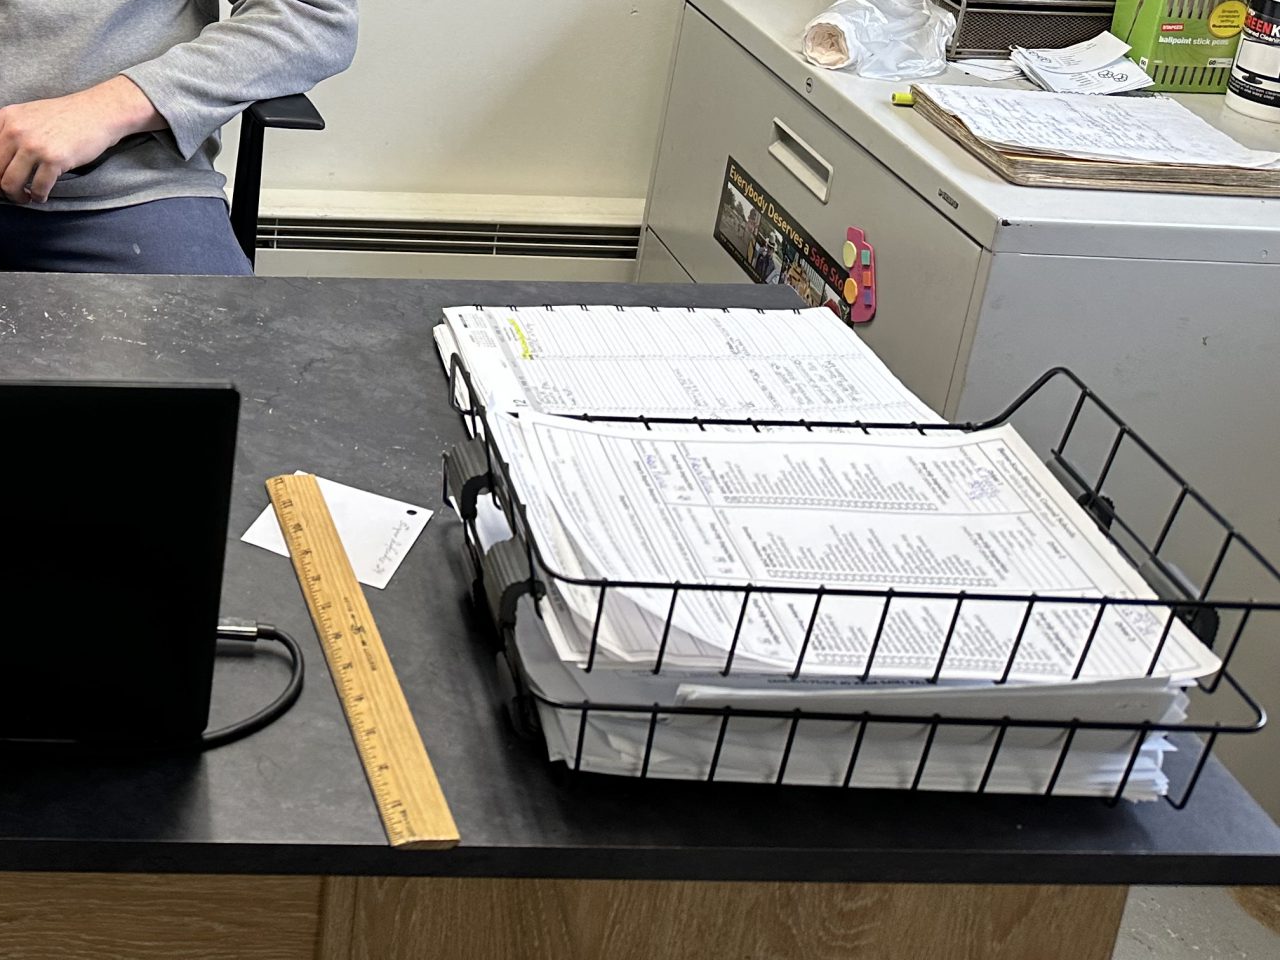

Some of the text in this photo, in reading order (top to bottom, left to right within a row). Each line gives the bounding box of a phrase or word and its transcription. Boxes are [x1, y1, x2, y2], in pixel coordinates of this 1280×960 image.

[1158, 35, 1229, 46] ballpoint stick pens
[729, 164, 768, 214] Everybody
[768, 203, 803, 249] Deserves
[803, 242, 810, 256] a
[810, 246, 829, 277] Safe
[828, 266, 846, 293] Sto
